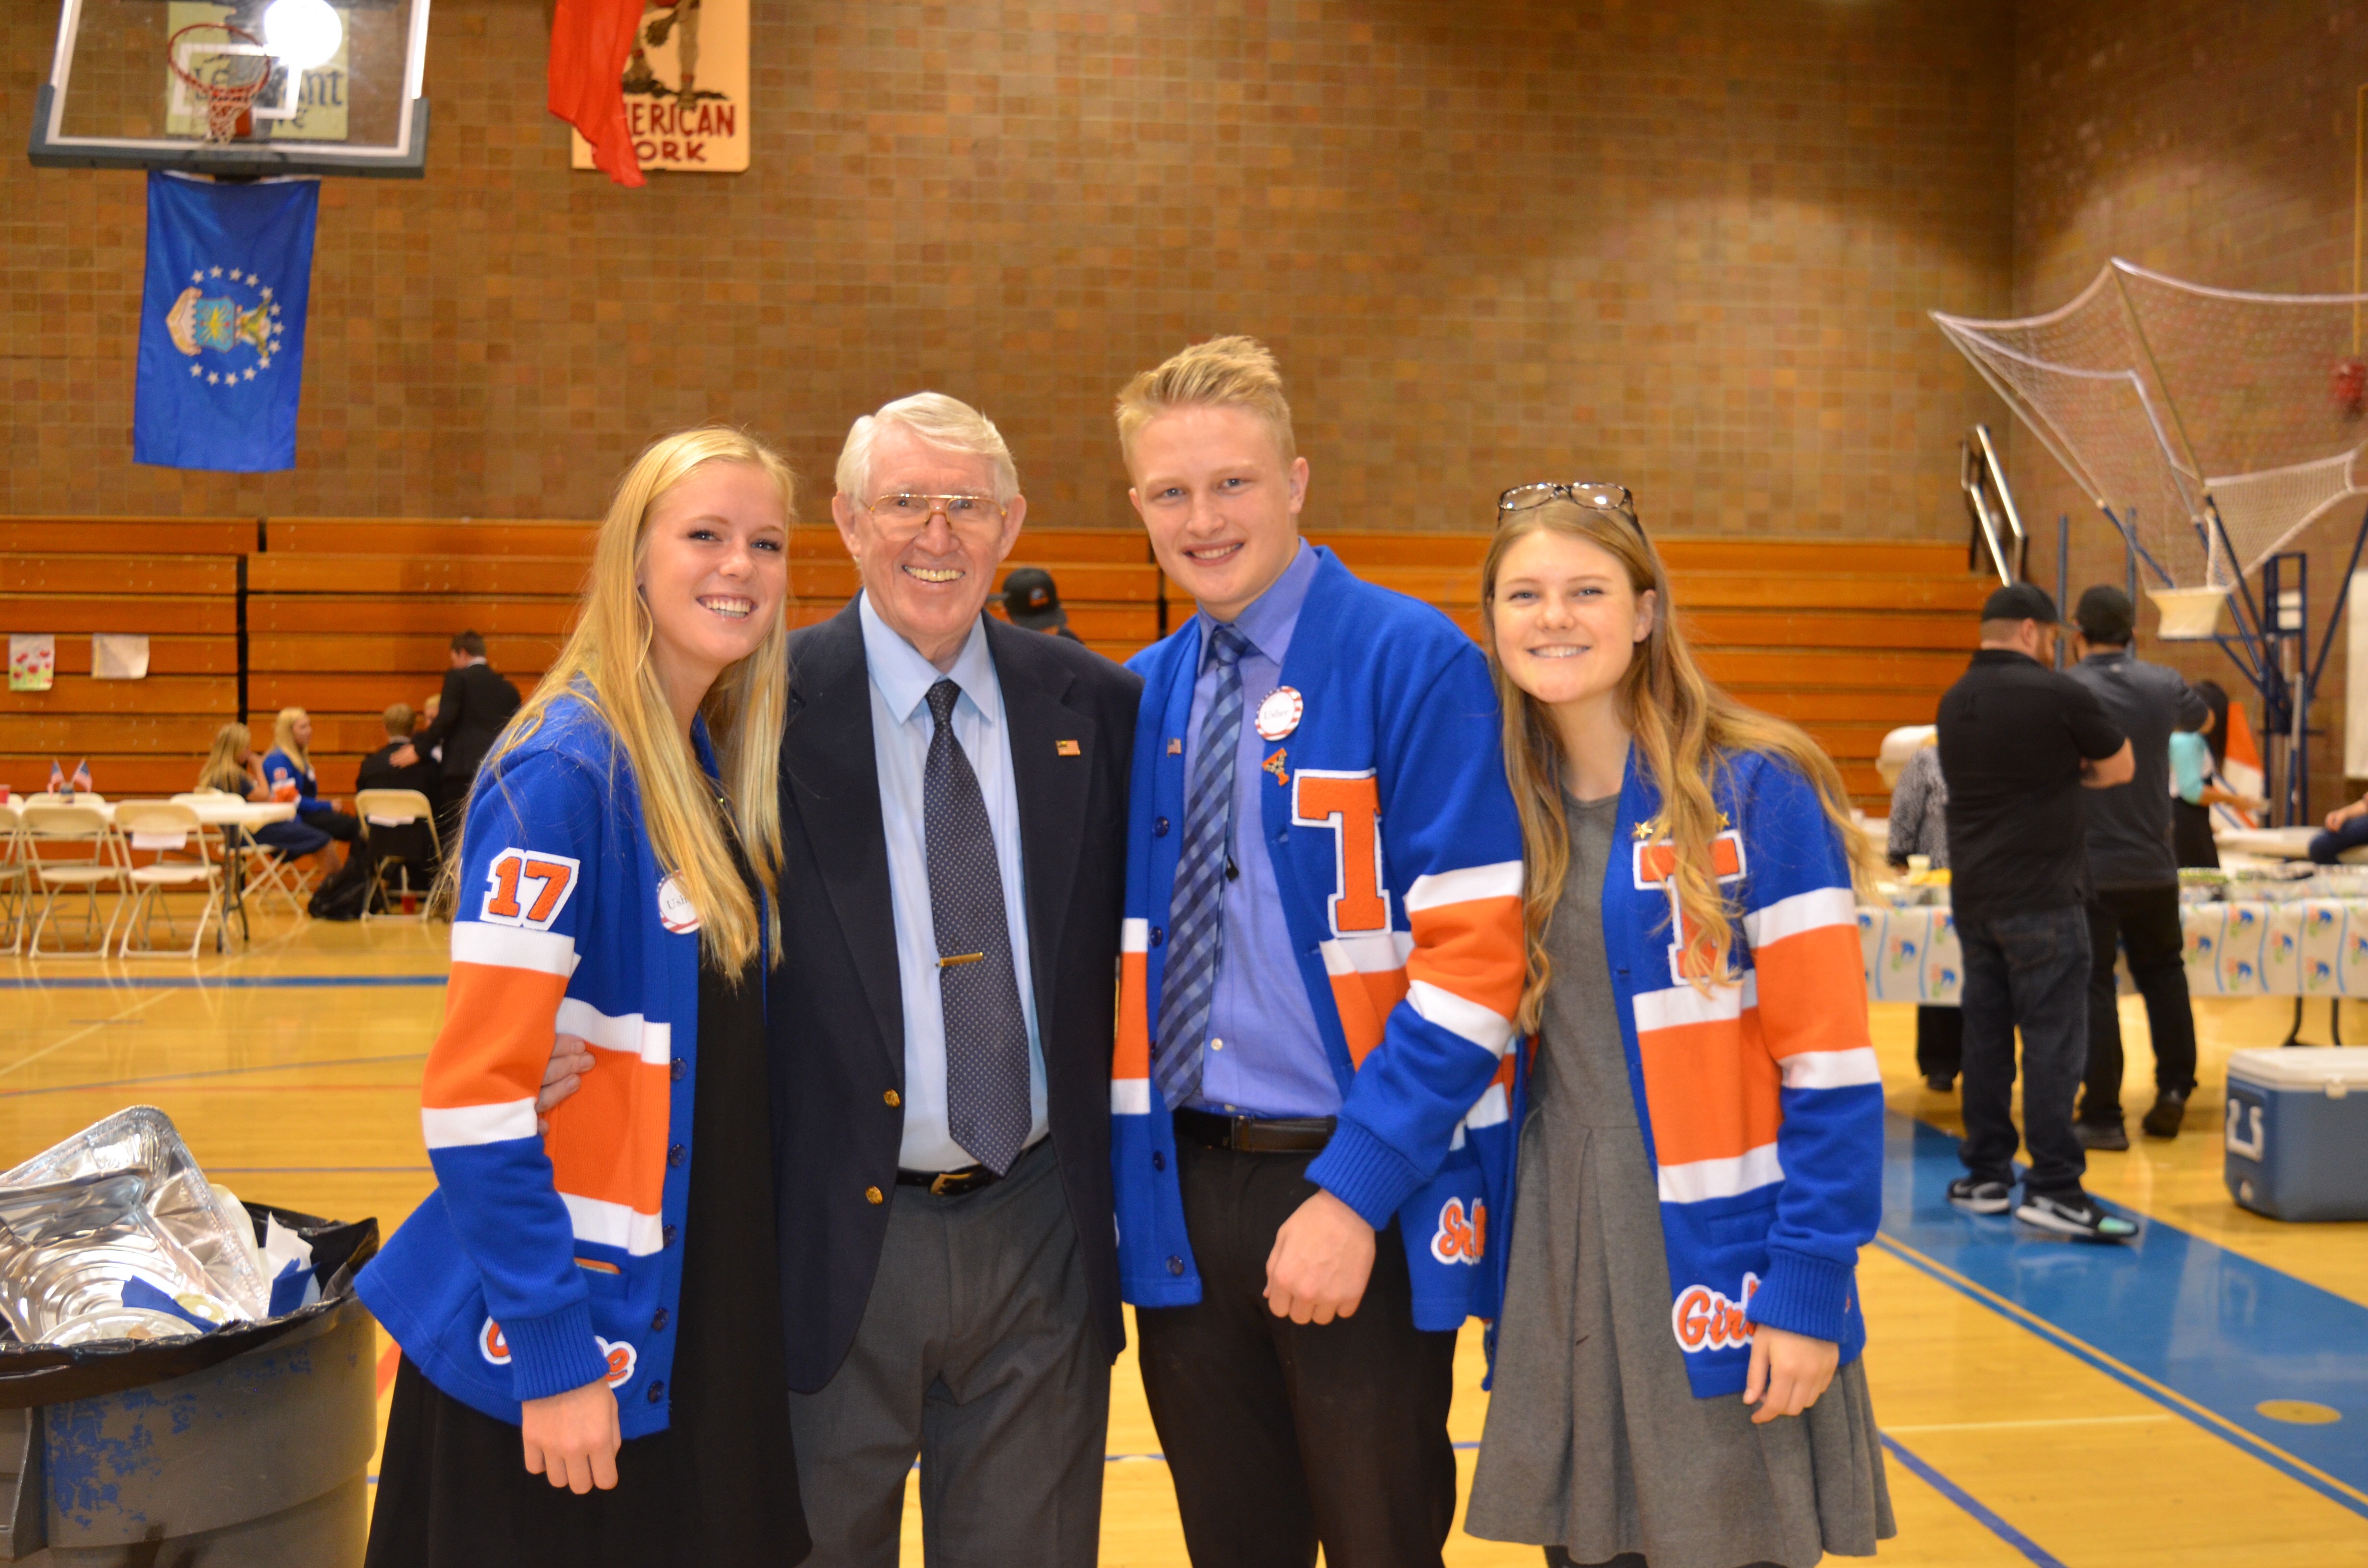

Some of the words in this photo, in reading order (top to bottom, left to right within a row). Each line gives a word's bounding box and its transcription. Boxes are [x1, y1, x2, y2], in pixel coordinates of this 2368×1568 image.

[624, 103, 735, 136] ERICAN
[634, 141, 706, 162] ORK
[1263, 709, 1290, 721] Usher
[1295, 772, 1389, 935] T
[484, 852, 576, 926] 17
[666, 894, 689, 909] Ush
